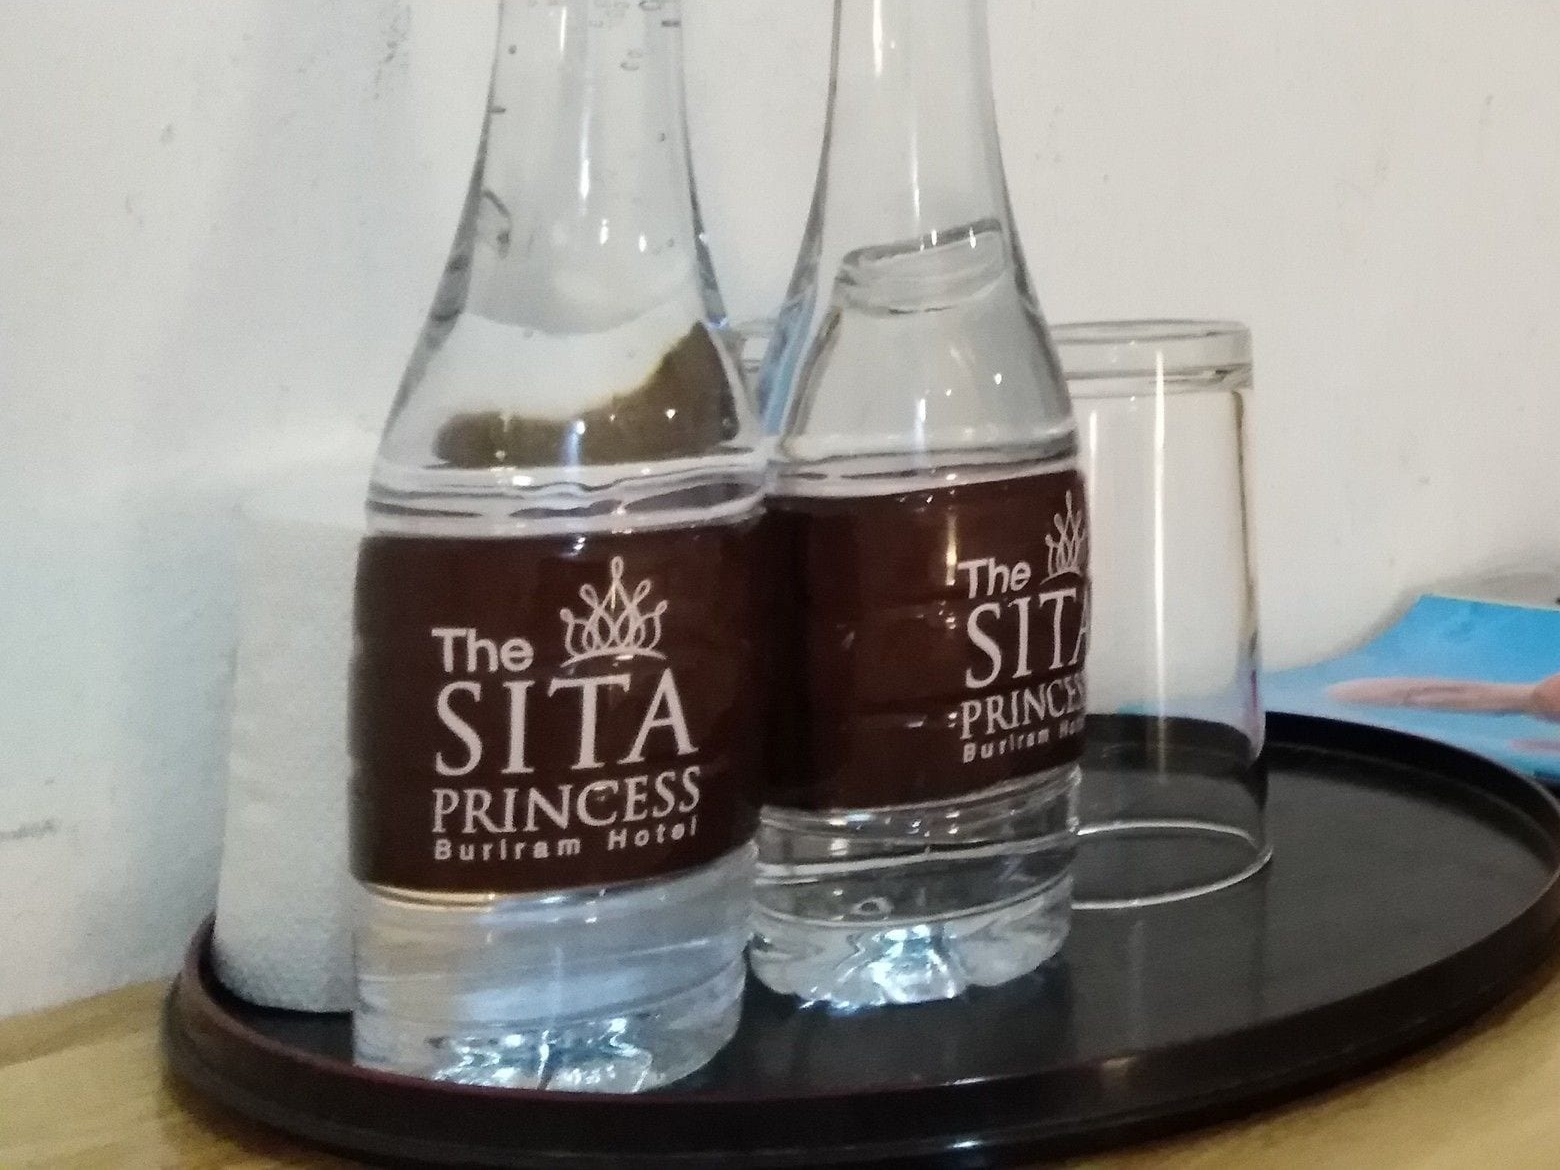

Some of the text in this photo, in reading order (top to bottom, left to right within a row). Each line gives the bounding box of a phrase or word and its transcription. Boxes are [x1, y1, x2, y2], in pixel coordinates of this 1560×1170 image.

[957, 557, 1032, 599] The
[431, 627, 535, 673] The
[434, 668, 700, 777] SITA
[960, 673, 1086, 740] PRINCE
[432, 765, 701, 834] PRINCESS
